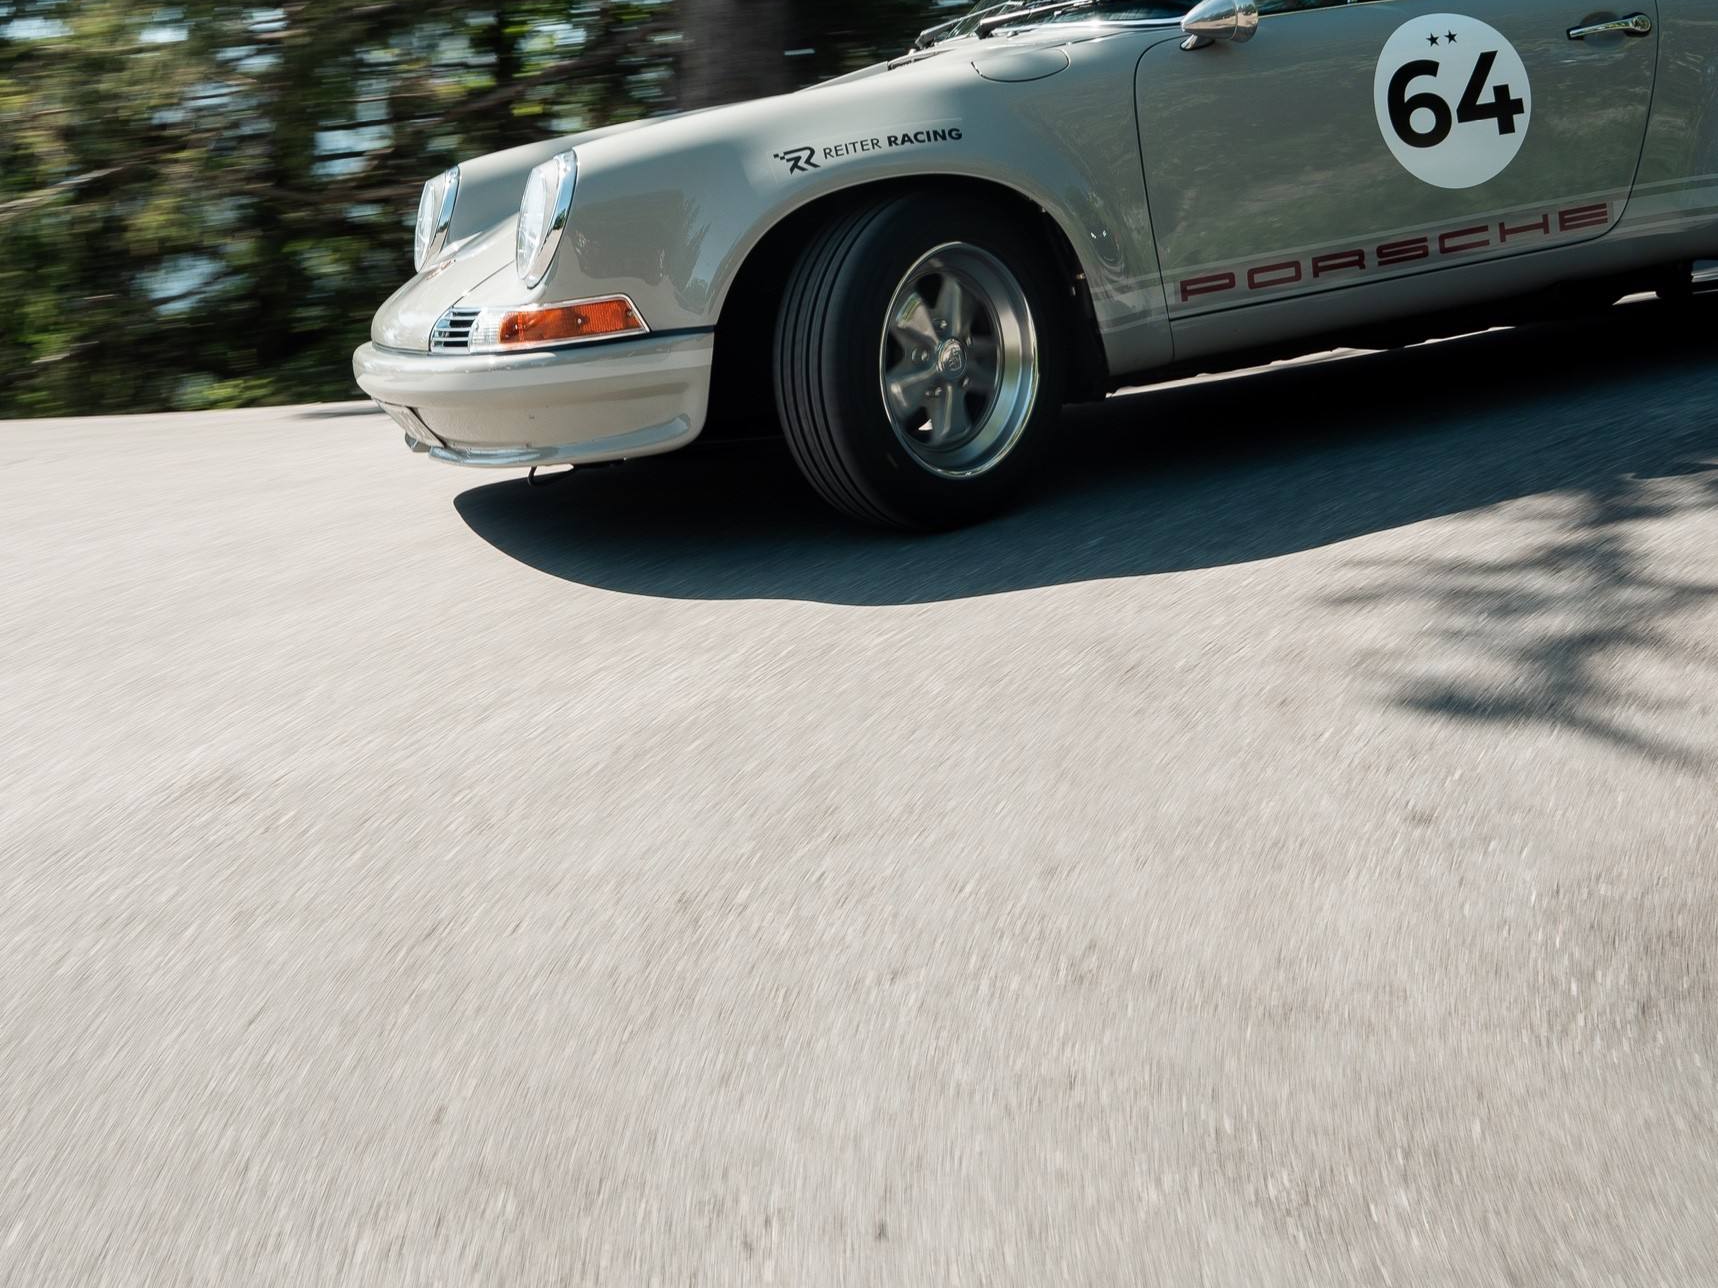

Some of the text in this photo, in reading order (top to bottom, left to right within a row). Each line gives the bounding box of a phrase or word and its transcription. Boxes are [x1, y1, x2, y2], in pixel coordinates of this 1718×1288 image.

[823, 138, 882, 160] REITER
[887, 127, 963, 147] RACING
[1387, 50, 1525, 148] 64
[1179, 202, 1609, 302] PORSCHE
